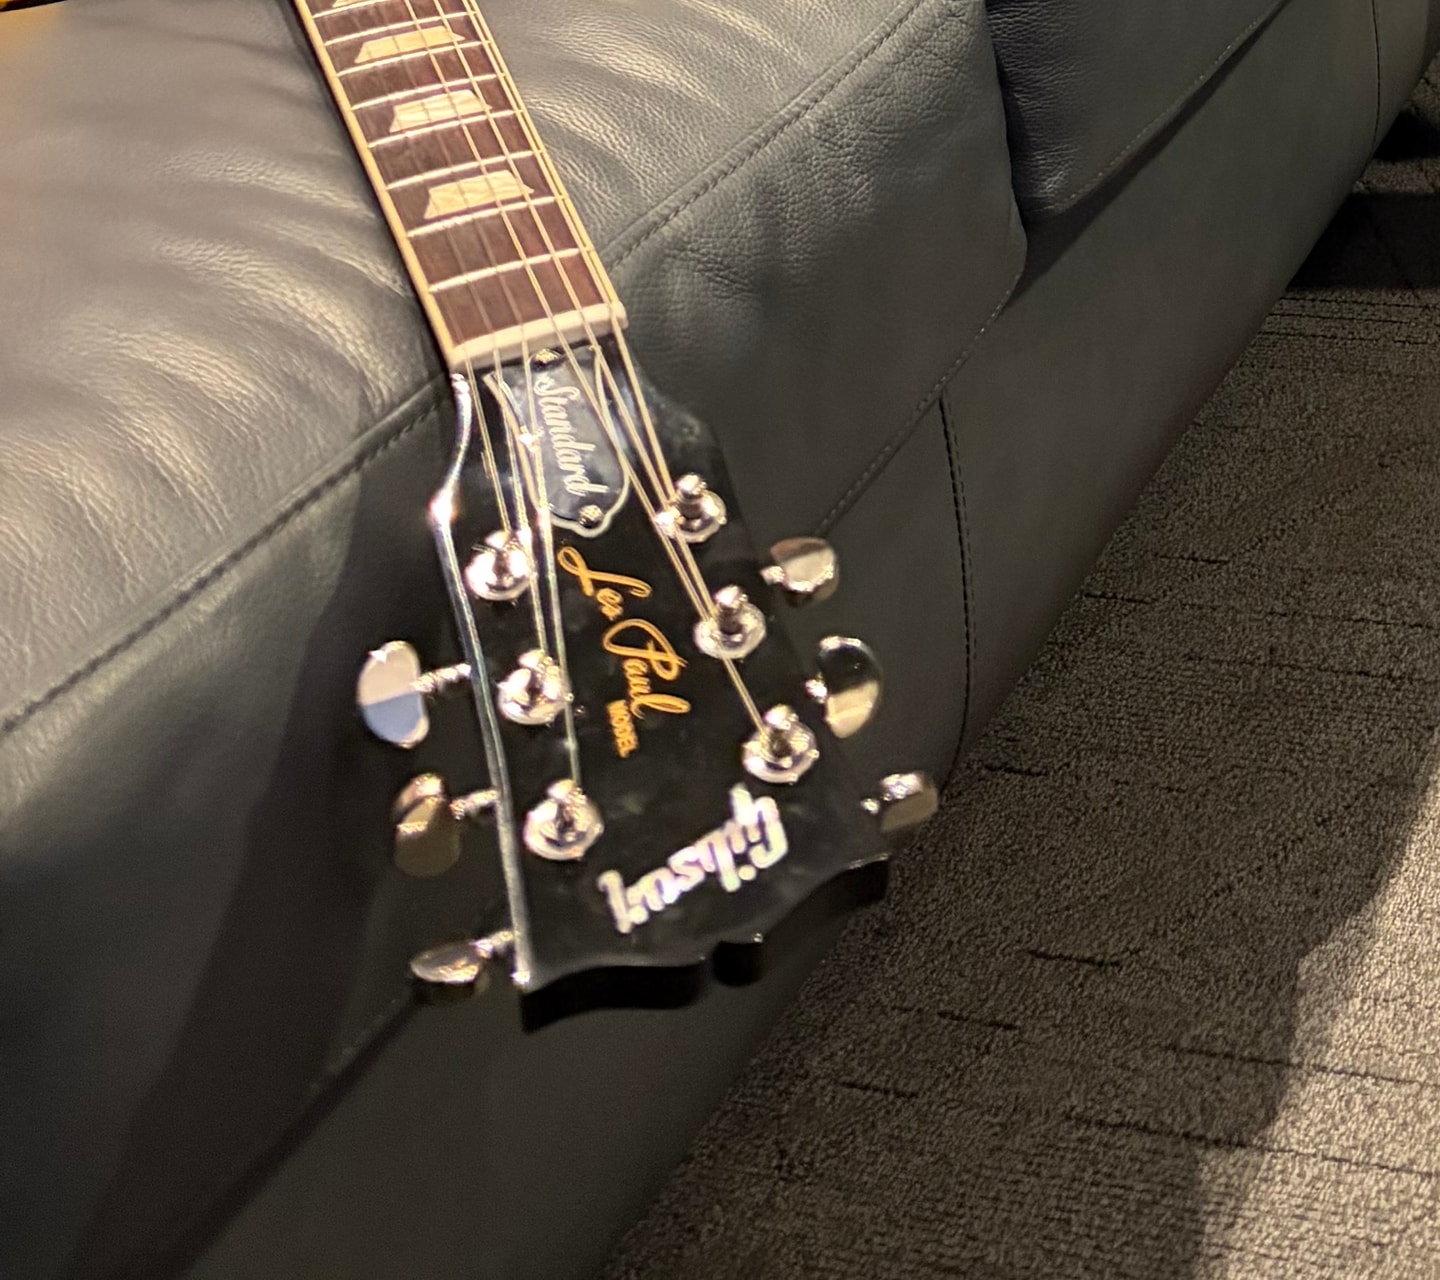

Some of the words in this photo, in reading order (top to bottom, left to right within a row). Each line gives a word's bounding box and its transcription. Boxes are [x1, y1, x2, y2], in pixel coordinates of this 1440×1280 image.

[534, 373, 609, 497] Standard
[557, 546, 652, 621] Les
[602, 618, 692, 720] Paul
[606, 699, 639, 758] MODEL
[598, 783, 788, 934] Gibson
